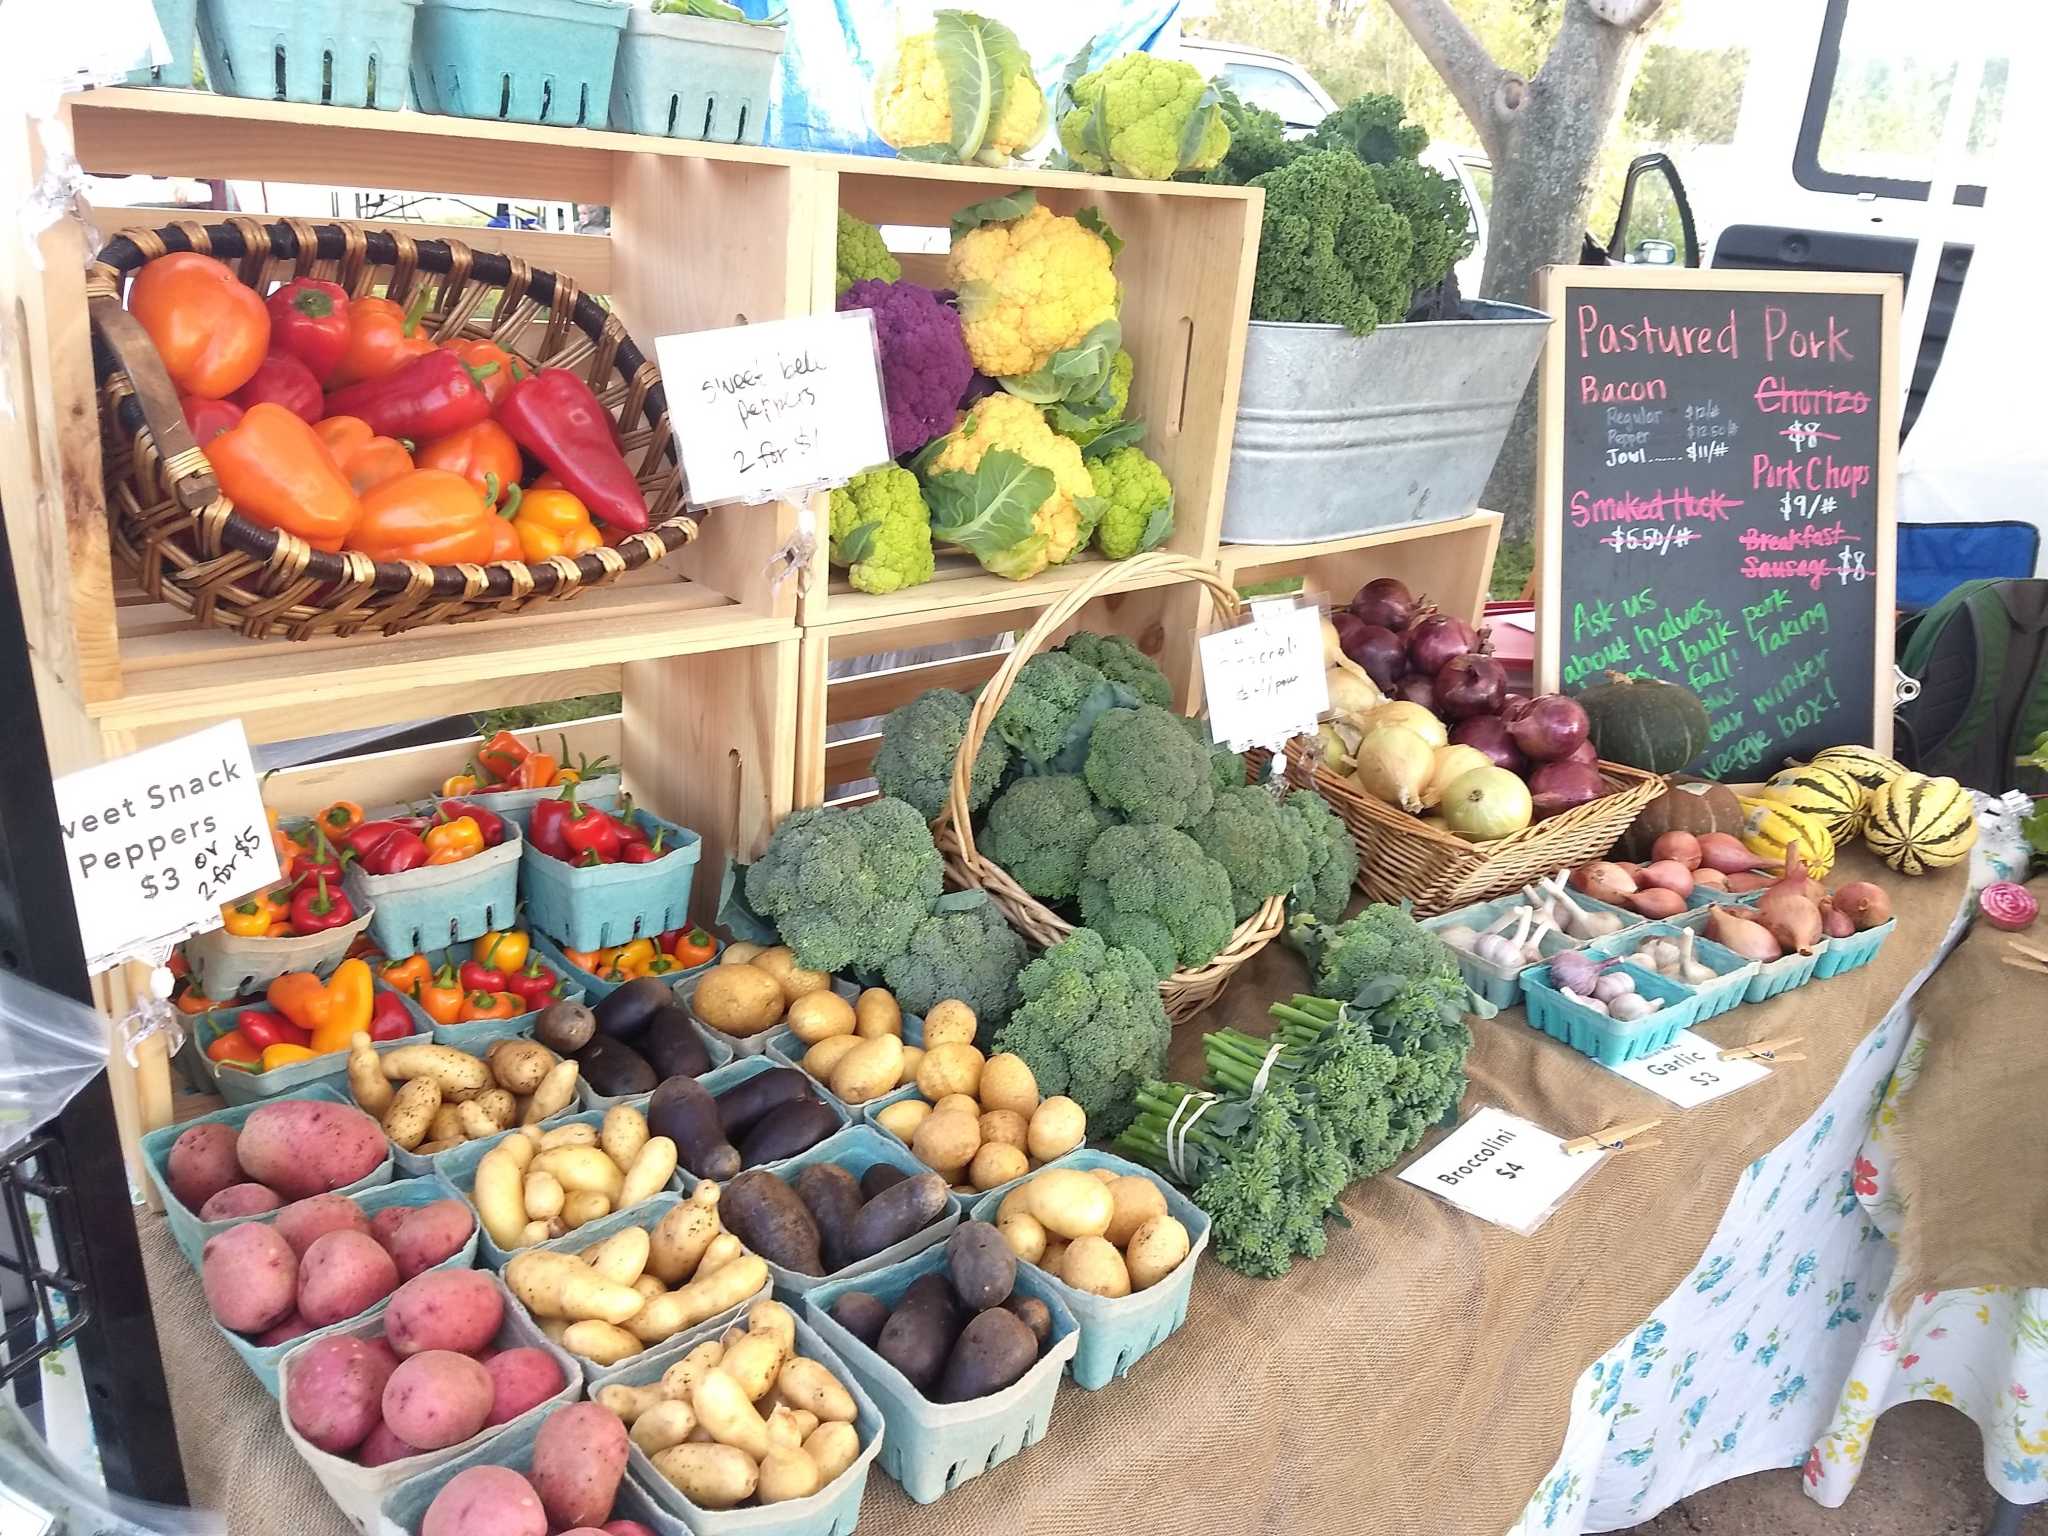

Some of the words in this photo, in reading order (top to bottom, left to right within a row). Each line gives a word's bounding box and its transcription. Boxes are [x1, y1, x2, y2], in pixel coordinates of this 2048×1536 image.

[1577, 304, 1738, 360] Pastured
[1764, 305, 1854, 362] Pork
[1581, 375, 1668, 405] Bacon
[1606, 405, 1663, 431] Regular
[1787, 419, 1821, 453] $8
[733, 450, 755, 474] 2
[757, 441, 788, 469] for
[1752, 453, 1802, 490] Pork
[1806, 454, 1870, 498] Chops
[1780, 491, 1838, 521] $9/#
[1837, 544, 1867, 586] $8
[1574, 599, 1619, 642] Ask
[1622, 587, 1657, 618] us
[1678, 620, 1740, 664] bulk
[1742, 589, 1793, 642] pork
[1757, 602, 1830, 657] Taking
[1563, 636, 1632, 685] about
[1708, 711, 1744, 742] our
[1753, 648, 1829, 715] winter
[1702, 730, 1773, 780] veggie
[1777, 676, 1841, 739] box!
[147, 759, 241, 810] Snack
[79, 815, 217, 879] Peppers
[140, 867, 181, 900] $3
[195, 840, 218, 869] or
[198, 881, 217, 901] 2
[212, 854, 238, 885] for
[234, 825, 260, 860] $5
[1647, 1052, 1707, 1076] Garlic
[1437, 1128, 1518, 1186] Broccolini
[1495, 1161, 1526, 1180] $4
